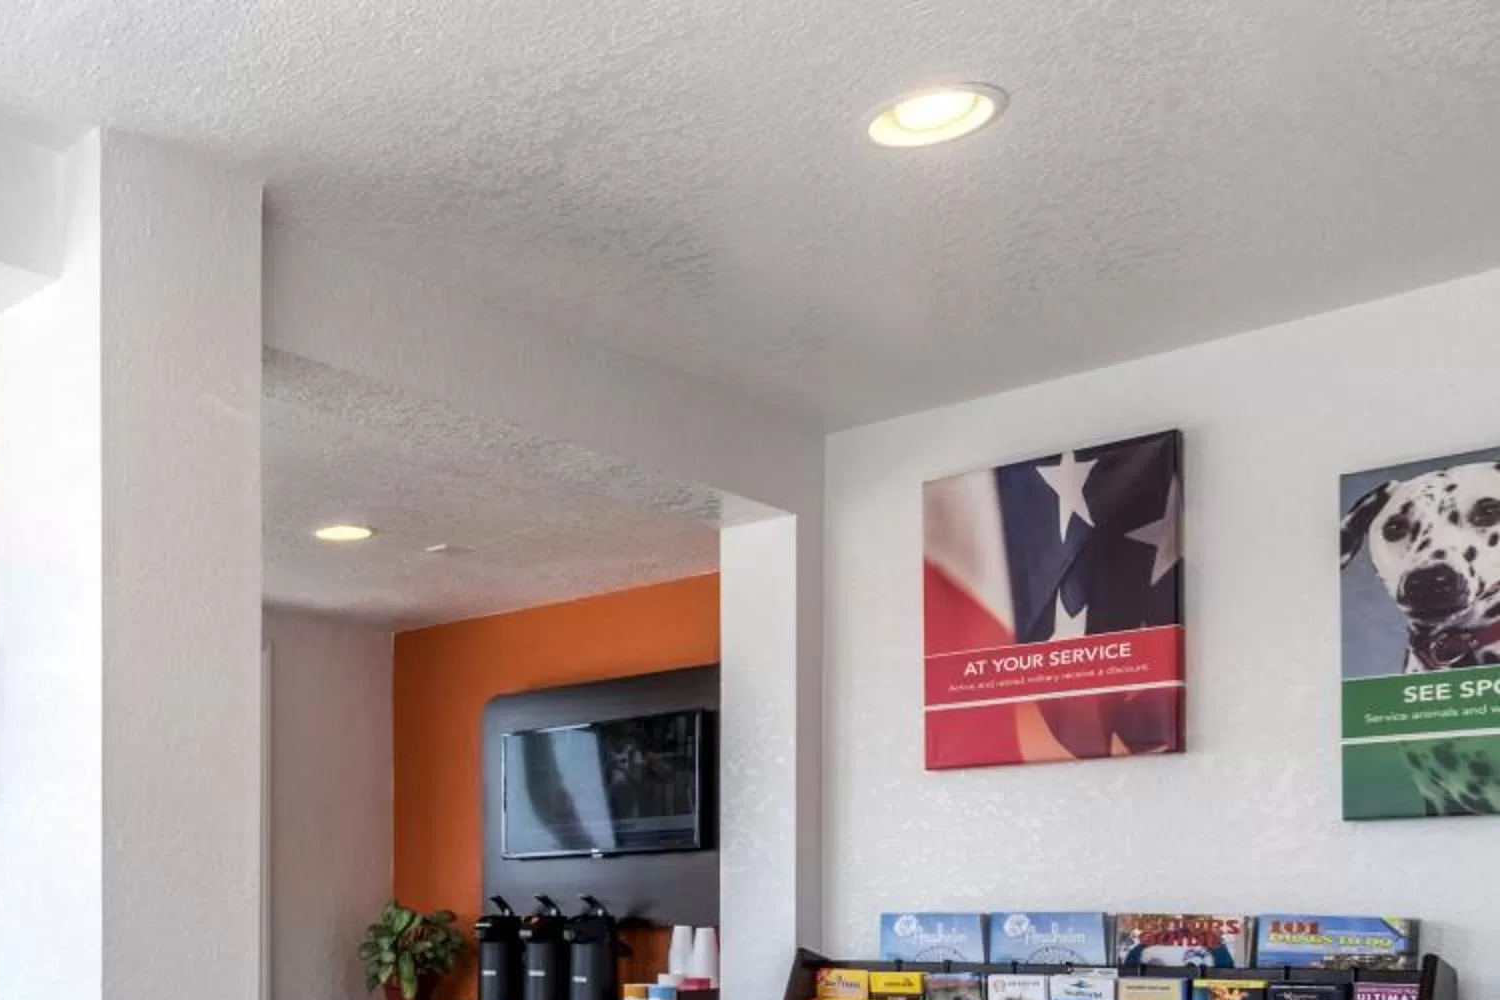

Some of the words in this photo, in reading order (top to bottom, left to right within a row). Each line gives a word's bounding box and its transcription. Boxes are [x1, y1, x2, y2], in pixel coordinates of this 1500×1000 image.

[963, 660, 986, 677] AT
[992, 654, 1044, 674] YOUR
[1048, 642, 1132, 667] SERVICE
[1403, 683, 1452, 703] SEE
